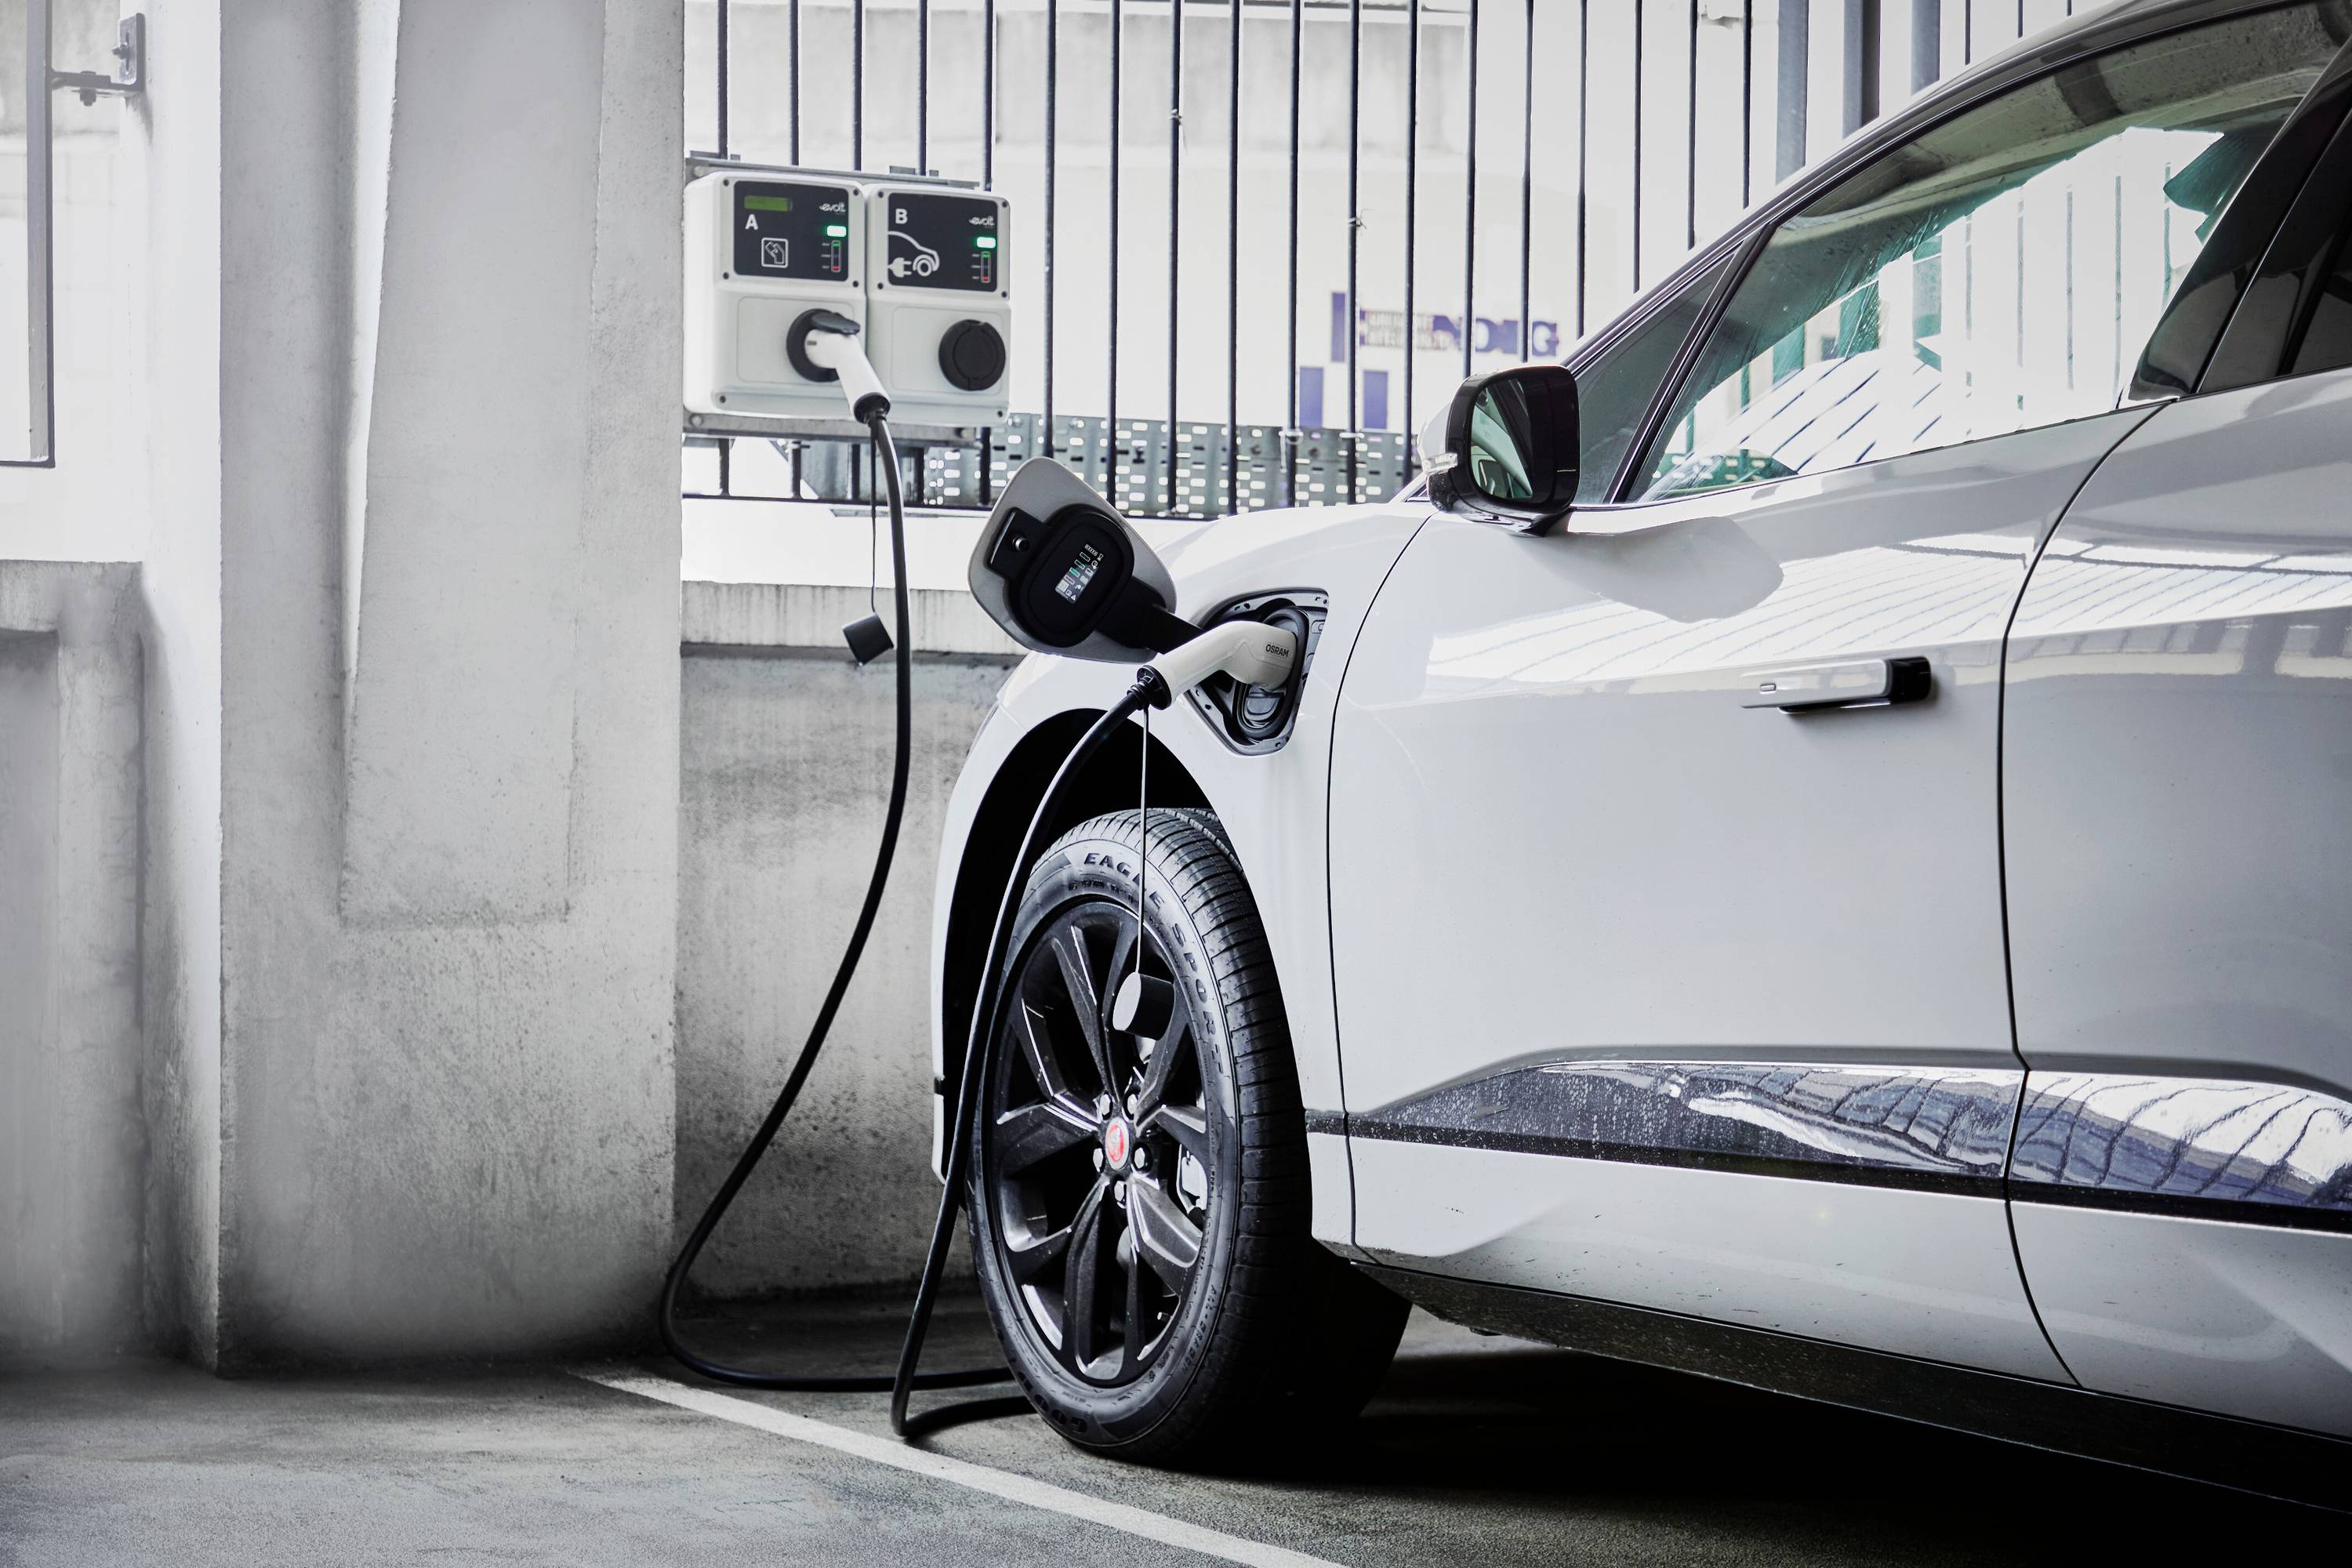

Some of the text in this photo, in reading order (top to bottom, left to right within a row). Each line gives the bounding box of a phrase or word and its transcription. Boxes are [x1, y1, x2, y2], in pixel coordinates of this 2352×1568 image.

[745, 213, 759, 230] A
[895, 208, 908, 224] B
[1265, 644, 1290, 658] OSRAM
